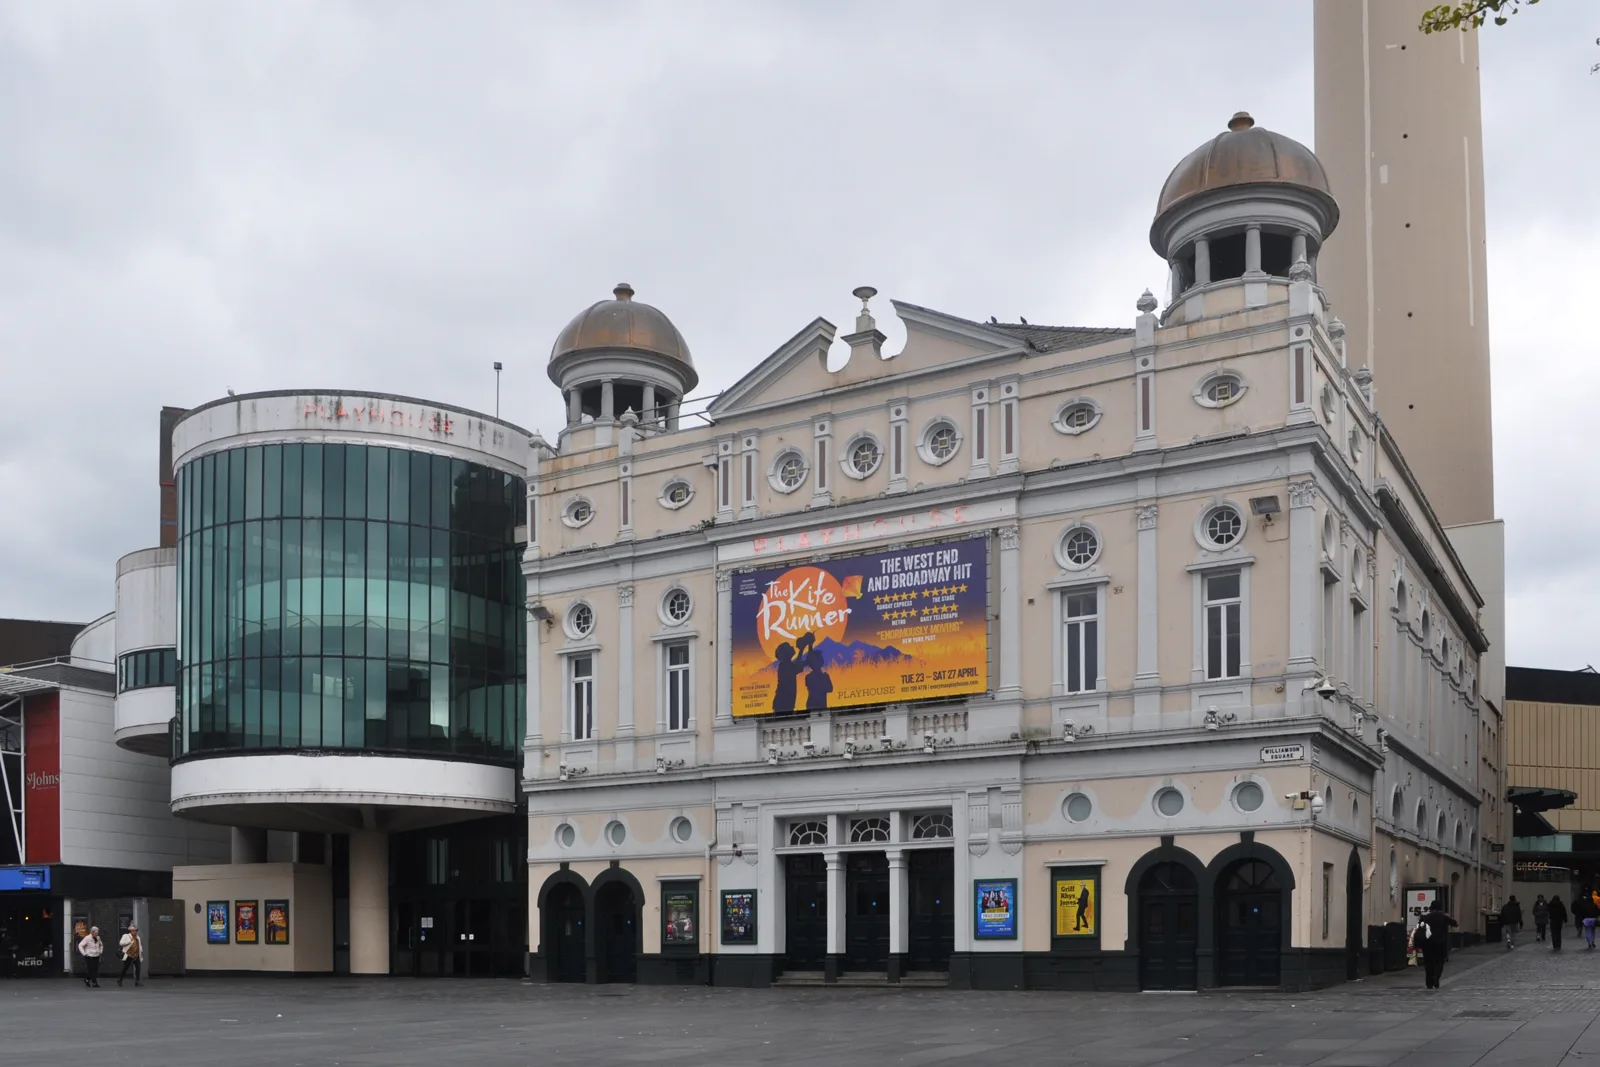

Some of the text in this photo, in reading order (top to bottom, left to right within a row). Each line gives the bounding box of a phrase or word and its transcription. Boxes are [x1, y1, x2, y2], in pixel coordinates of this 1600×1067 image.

[303, 402, 455, 435] PLAYHOUSE
[754, 505, 968, 556] PLAYHOUSE
[880, 548, 959, 574] THE WEST END
[867, 563, 972, 592] AND BROADWAY HIT
[765, 580, 788, 599] The
[787, 571, 836, 615] Kite
[942, 594, 955, 602] STAGE
[893, 600, 912, 608] EXPRESS
[756, 593, 852, 640] Runner
[933, 612, 958, 621] TELEGRAPH
[901, 674, 914, 684] TUE
[916, 673, 924, 683] 23
[933, 671, 946, 681] SAT
[948, 669, 956, 679] 27
[957, 667, 978, 678] APRIL
[838, 686, 895, 699] PLAYHOUSE
[1516, 862, 1548, 870] GREGGS
